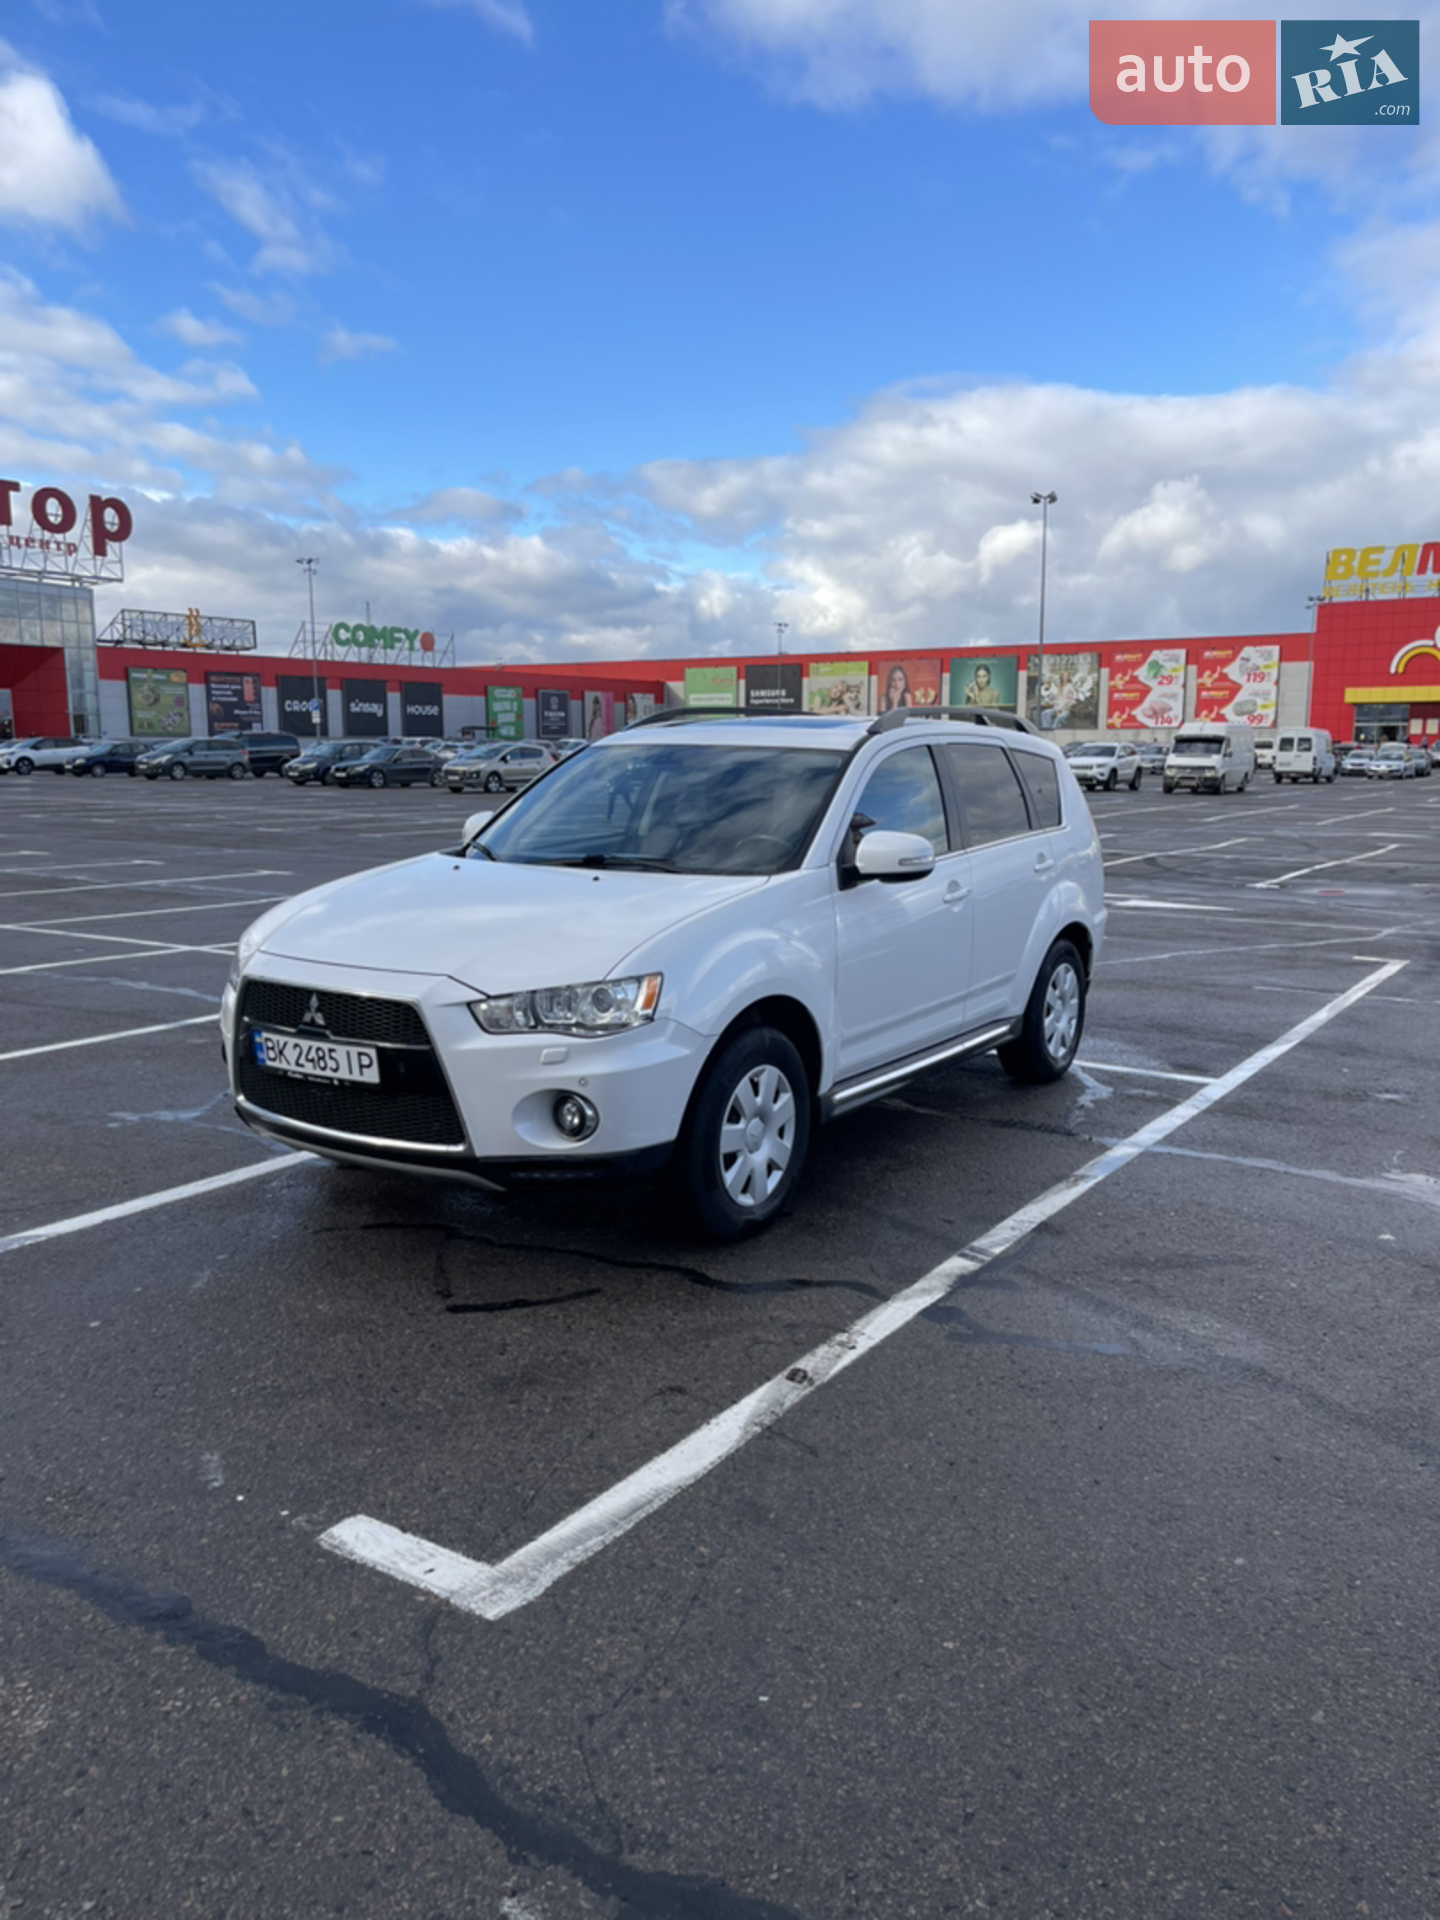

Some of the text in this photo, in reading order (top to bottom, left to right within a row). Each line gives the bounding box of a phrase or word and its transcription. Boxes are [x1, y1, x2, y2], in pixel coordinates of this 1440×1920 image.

[331, 621, 420, 651] COMFY
[1157, 675, 1174, 686] 29
[1246, 672, 1266, 683] 119
[750, 689, 786, 698] SAMSUNG
[349, 699, 384, 717] sinsay
[264, 1037, 291, 1066] BK
[292, 1043, 341, 1073] 2485
